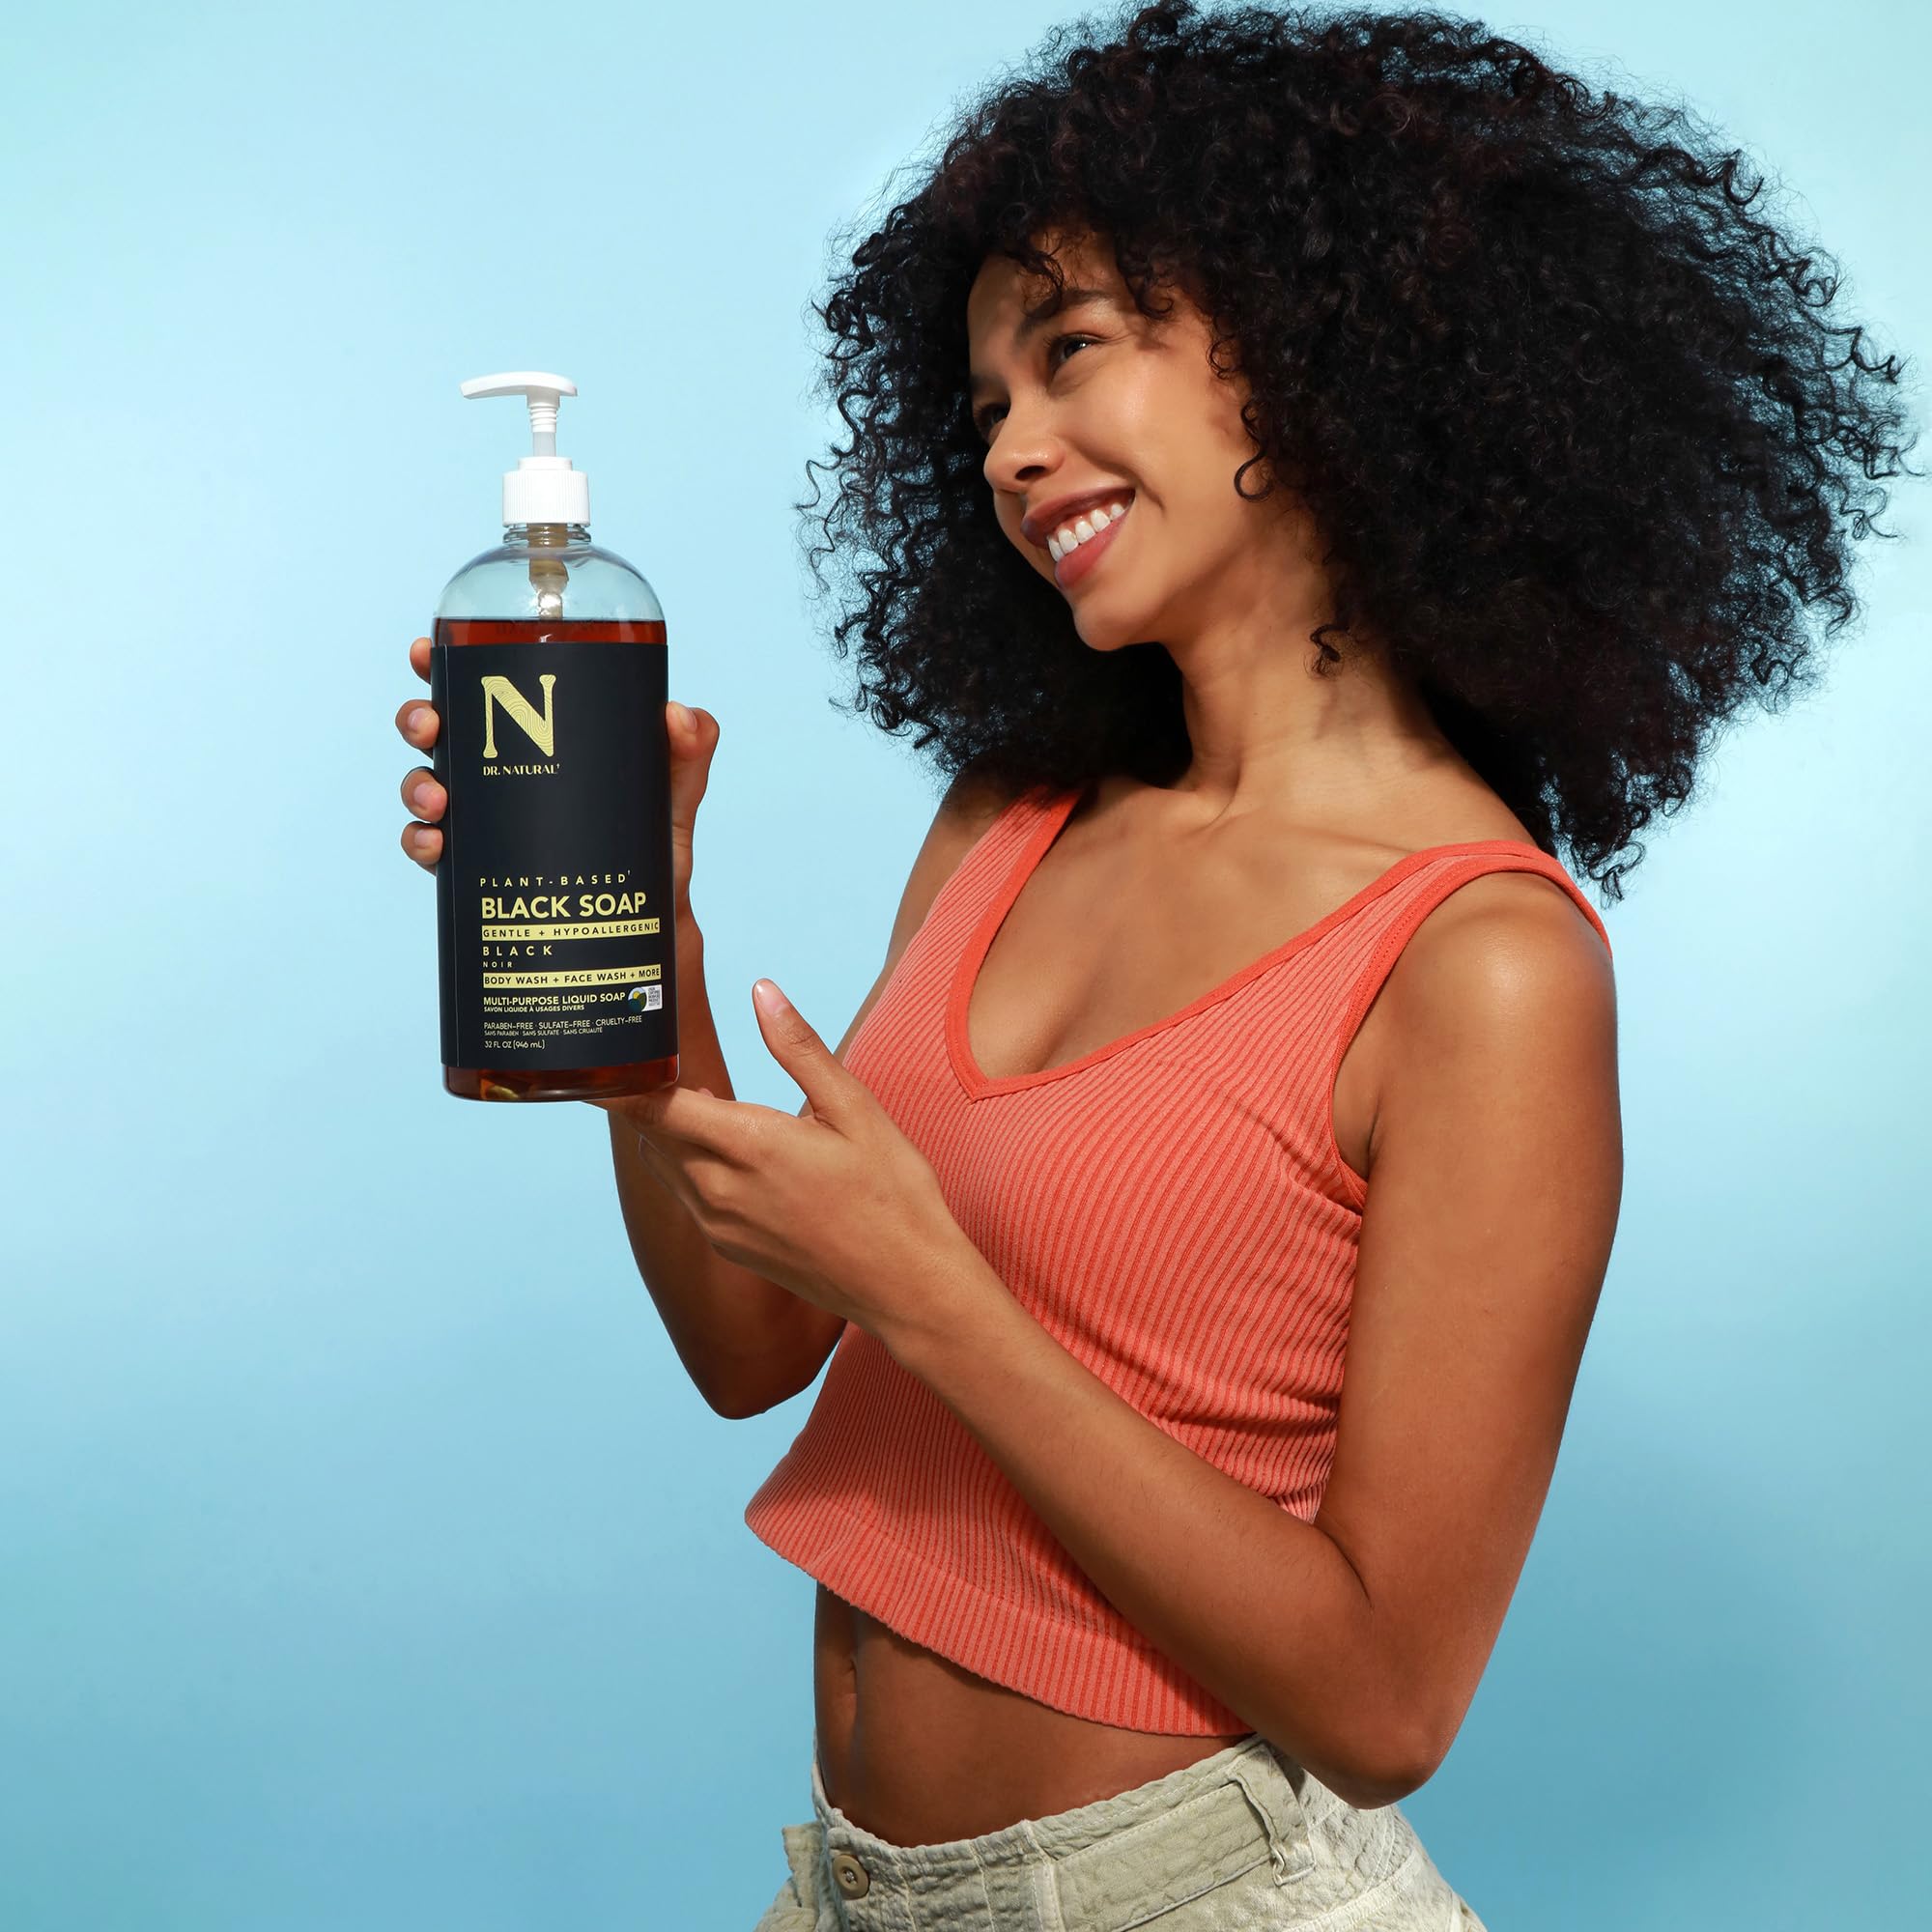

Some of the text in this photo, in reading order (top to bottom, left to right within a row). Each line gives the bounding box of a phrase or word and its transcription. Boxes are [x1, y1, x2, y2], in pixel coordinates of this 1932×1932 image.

[481, 674, 556, 758] N
[483, 766, 500, 776] DR.
[482, 893, 646, 919] BLACK SOAP
[483, 929, 530, 938] GENTLE
[554, 922, 659, 936] HYPOALLERGENIC
[483, 946, 553, 956] BLACK
[516, 976, 548, 984] WASH
[564, 974, 592, 983] FACE
[597, 971, 626, 980] WASH
[639, 968, 660, 978] MORE
[484, 992, 626, 1005] MULTI-PURPOSE LIQUID SOAP
[539, 1020, 590, 1029] SULFATE-FREE
[595, 1015, 642, 1027] CRUELTY-FREE
